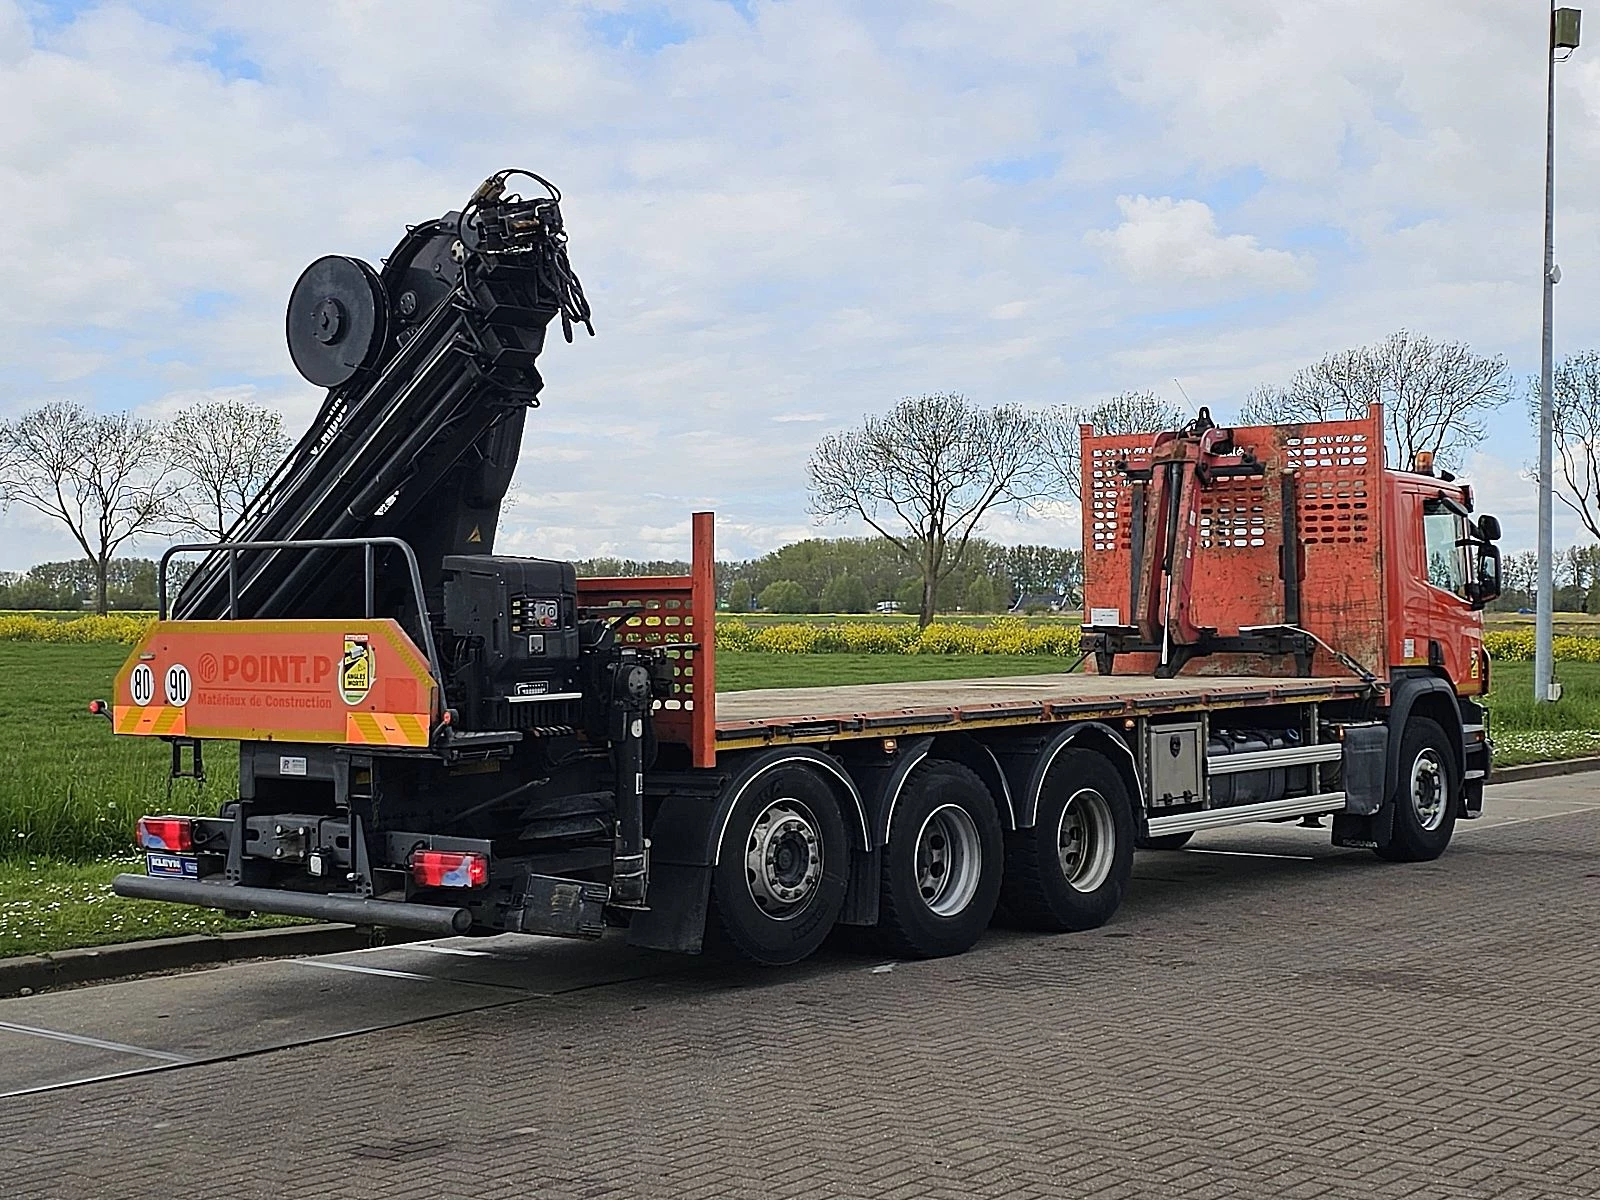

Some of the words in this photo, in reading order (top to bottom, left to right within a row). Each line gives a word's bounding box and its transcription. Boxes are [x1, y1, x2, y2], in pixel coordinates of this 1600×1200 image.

[223, 654, 332, 683] POINT.P
[135, 668, 150, 700] 80
[170, 669, 186, 701] 90
[198, 693, 247, 707] Matériaux
[249, 695, 262, 707] de
[264, 695, 332, 709] Construction
